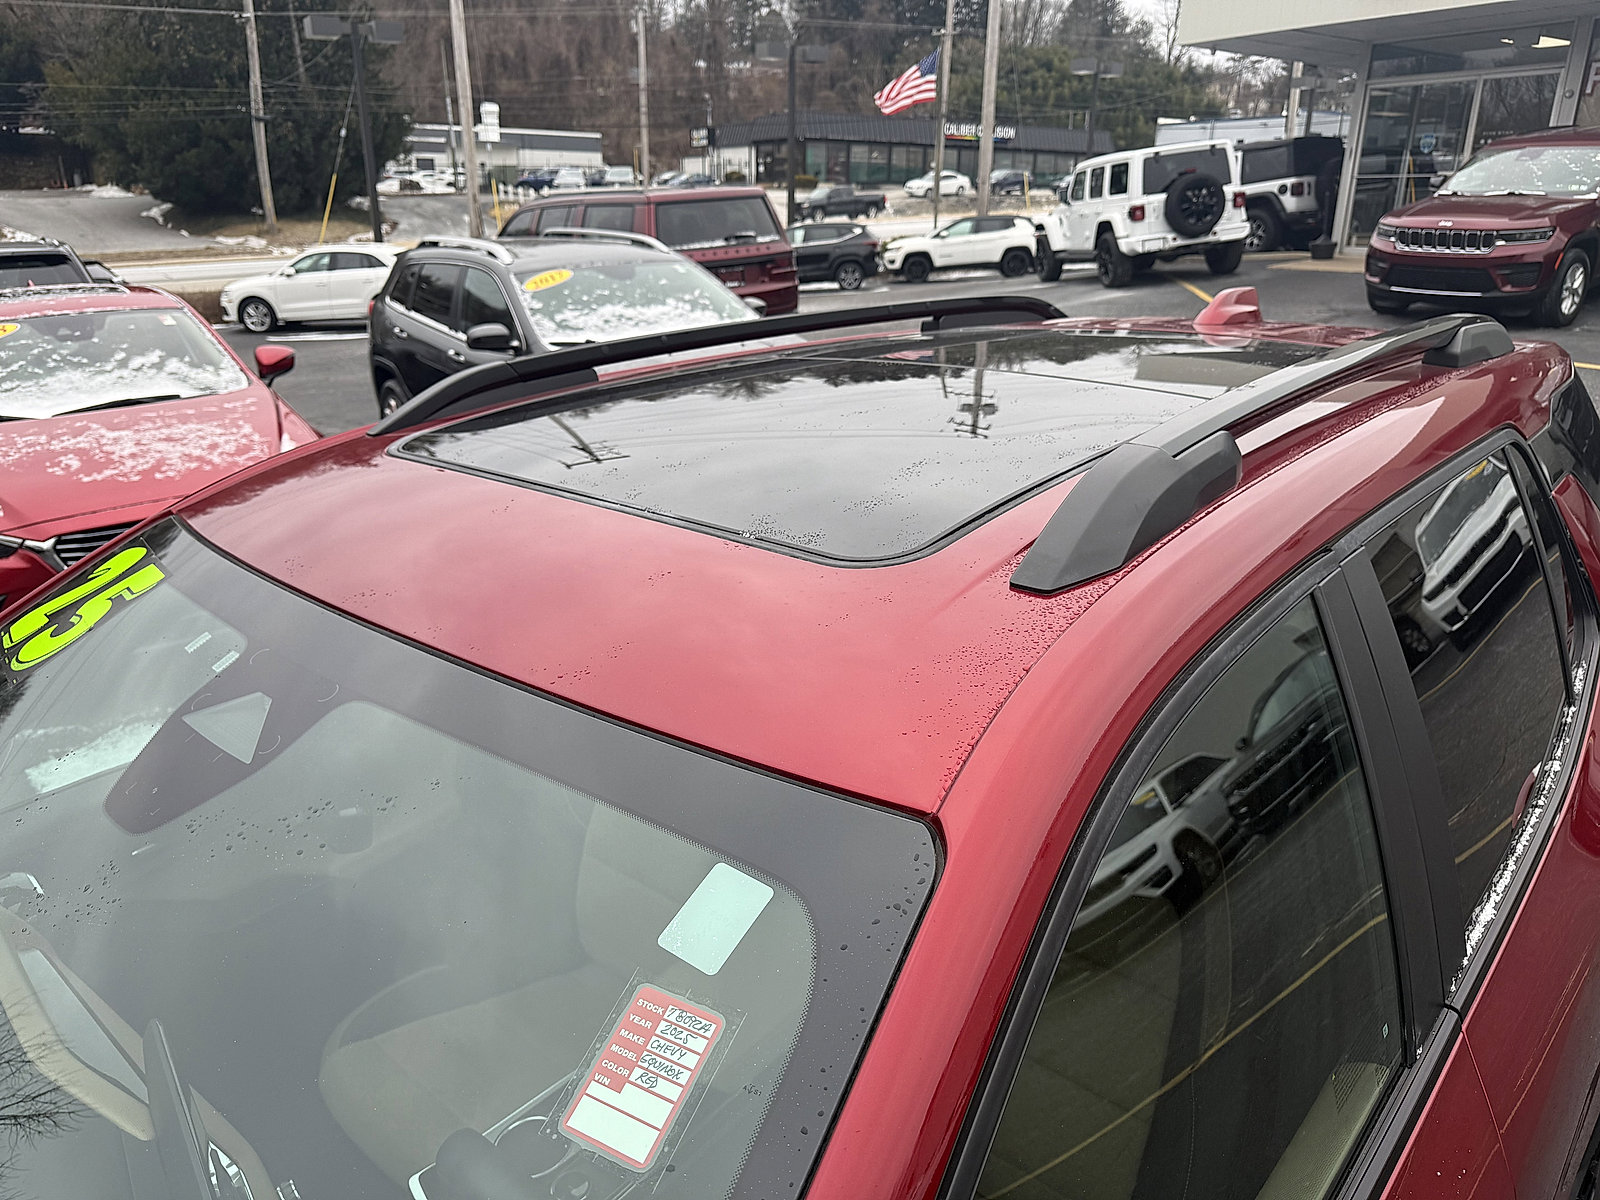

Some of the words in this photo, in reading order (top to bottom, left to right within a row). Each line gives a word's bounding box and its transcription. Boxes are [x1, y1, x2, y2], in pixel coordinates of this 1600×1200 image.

[2, 547, 165, 671] 25
[636, 998, 665, 1015] STOCK
[629, 1013, 653, 1029] YEAR
[660, 1024, 698, 1044] 2025
[610, 1043, 637, 1062] MODEL
[619, 1028, 646, 1045] MAKE
[650, 1039, 687, 1060] CHEVY
[594, 1072, 611, 1086] VIN
[601, 1059, 630, 1077] COLOR
[635, 1071, 659, 1089] RED
